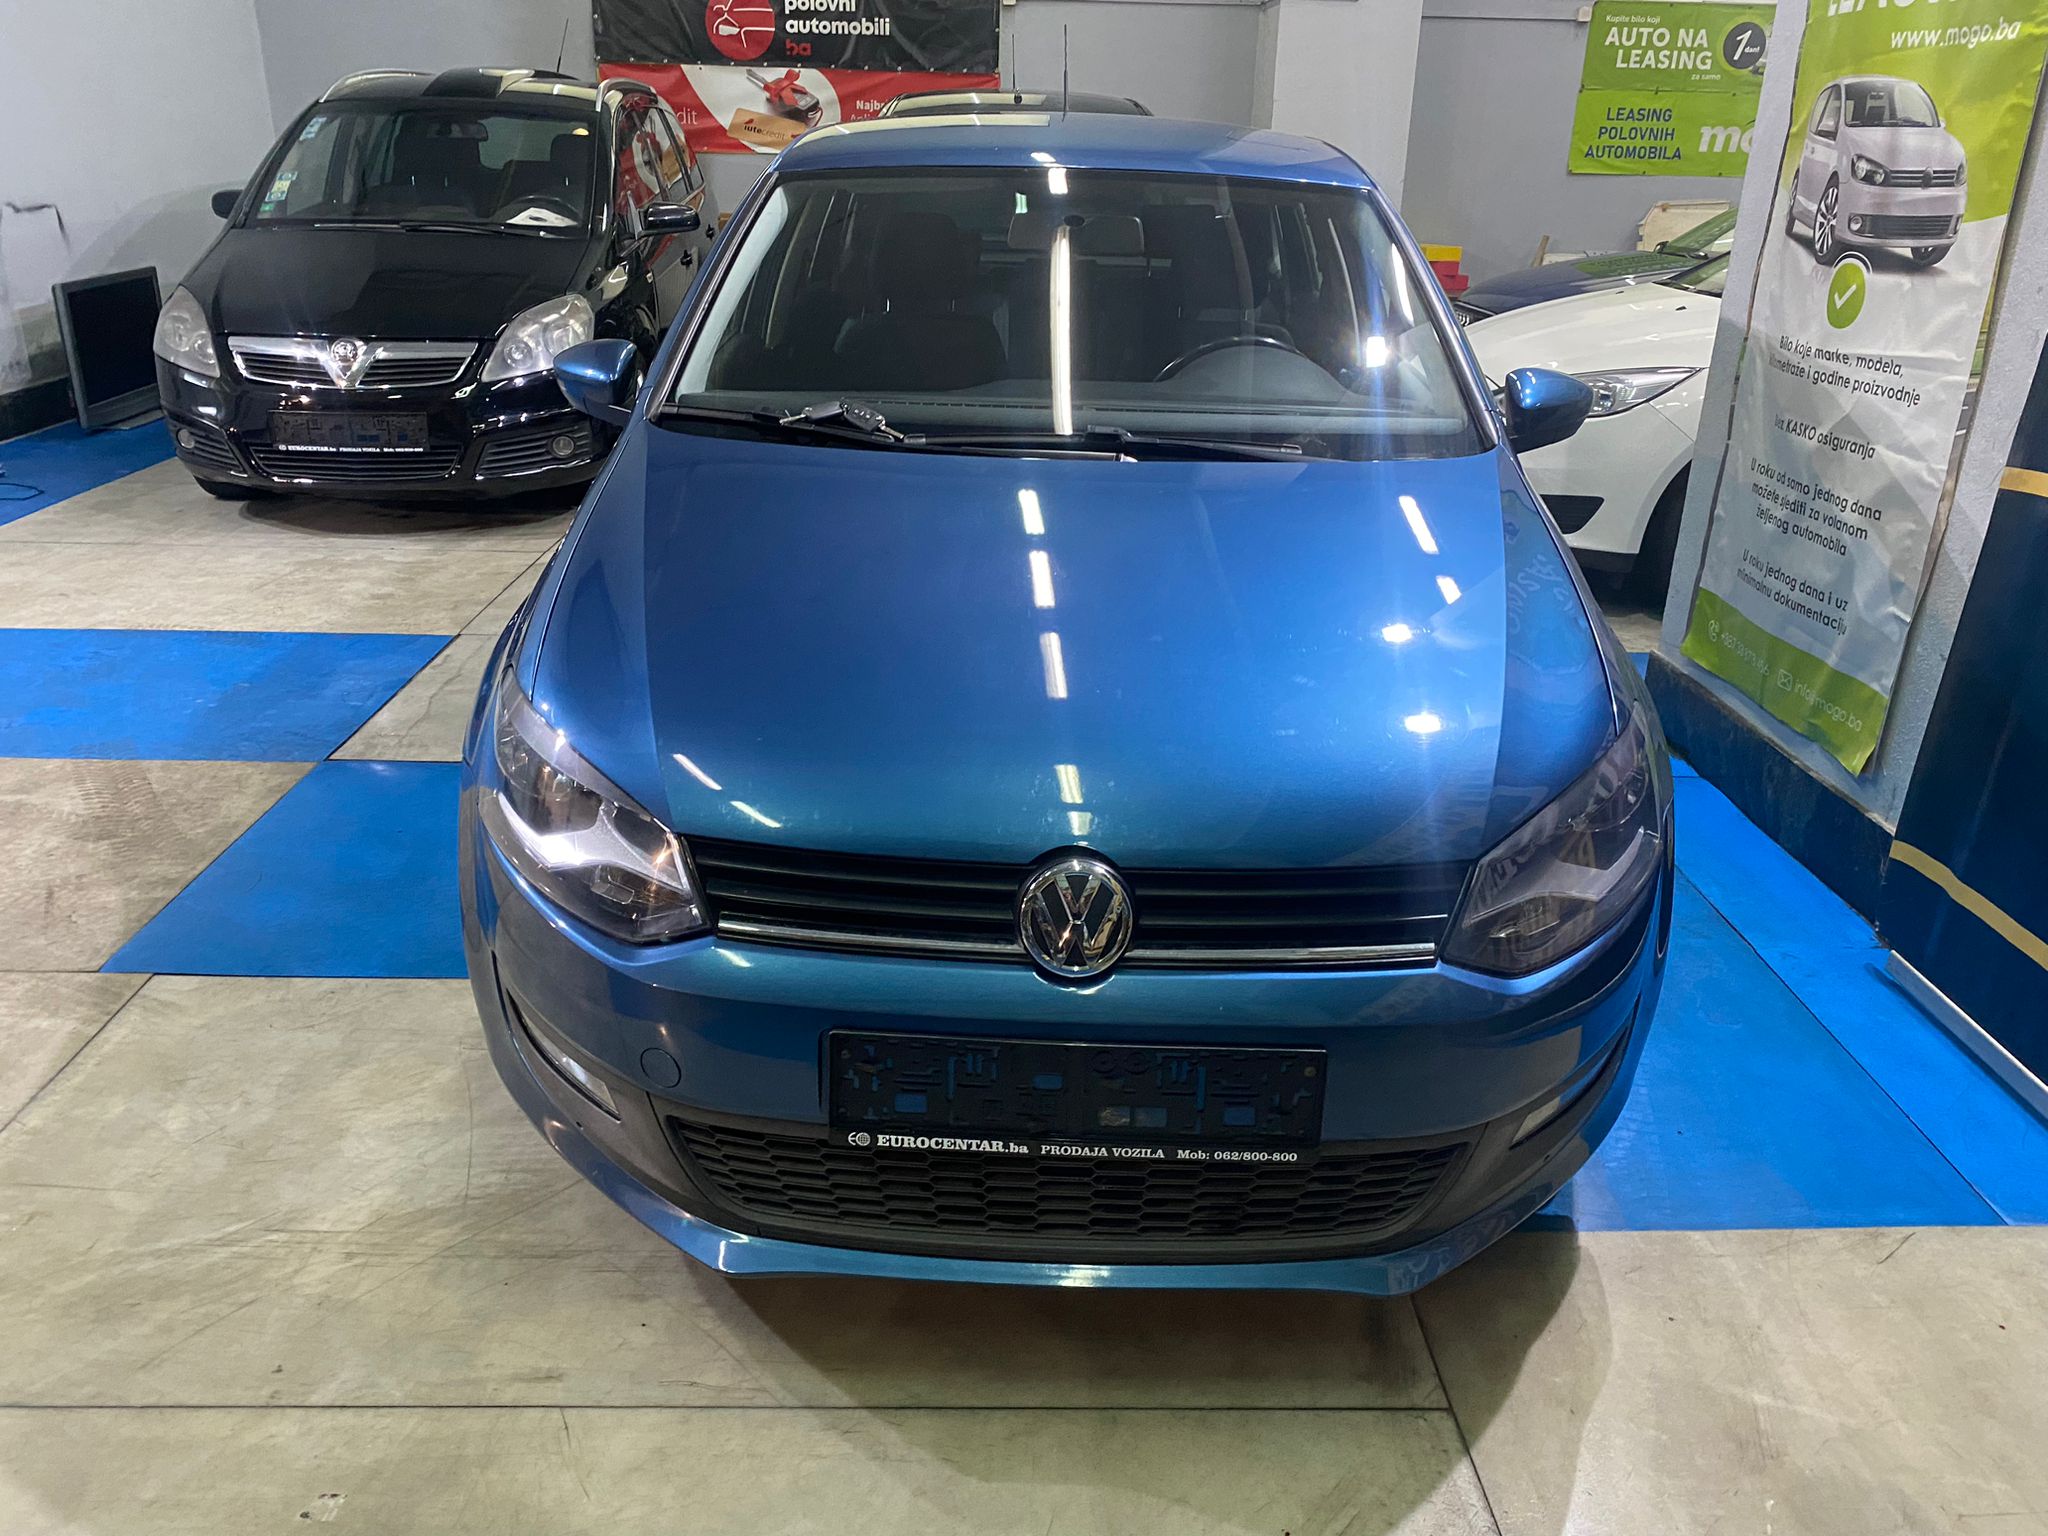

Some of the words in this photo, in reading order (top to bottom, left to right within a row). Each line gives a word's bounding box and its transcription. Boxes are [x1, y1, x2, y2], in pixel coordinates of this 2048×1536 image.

[784, 0, 856, 14] polovni
[1631, 14, 1646, 22] bilo
[785, 17, 890, 36] automobili
[1604, 27, 1670, 47] AUTO
[1677, 28, 1709, 48] NA
[1891, 17, 2022, 49] www.mogo.ba
[1733, 30, 1752, 60] 1
[1615, 49, 1713, 70] LEASING
[676, 106, 698, 125] dit
[856, 99, 886, 112] Najbr
[1606, 107, 1673, 122] LEASING
[1598, 126, 1675, 141] POLOVNIH
[1698, 125, 1754, 153] mo
[1584, 145, 1682, 161] AUTOMOBILA
[1779, 335, 1793, 352] Bilo
[1794, 339, 1812, 360] koje
[1814, 348, 1852, 367] marke,
[1856, 356, 1904, 379] modela,
[1806, 365, 1812, 380] i
[1812, 369, 1851, 388] godine
[1851, 378, 1921, 407] proizvodnje
[1785, 418, 1817, 440] KASKO
[1817, 431, 1876, 461] osiguranja
[1750, 458, 1757, 471] U
[1756, 462, 1776, 480] roku
[1776, 471, 1786, 485] od
[1786, 478, 1810, 495] samo
[1812, 483, 1849, 513] jednog
[1850, 499, 1882, 521] dana
[1751, 481, 1780, 504] možete
[1808, 507, 1821, 521] za
[1823, 513, 1869, 541] volanom
[1756, 504, 1790, 535] željenog
[1792, 523, 1847, 556] automobila
[1742, 548, 1749, 562] U
[1764, 562, 1798, 592] jednog
[1799, 580, 1825, 602] dana
[1827, 591, 1832, 606] i
[1835, 597, 1849, 612] uz
[1773, 590, 1848, 636] dokumentaciju
[877, 1134, 1029, 1154] EUROCENTAR.ba
[1040, 1144, 1109, 1158] PRODAJA
[1112, 1147, 1165, 1159] VOZILA
[1176, 1149, 1211, 1161] Mob:
[1214, 1150, 1298, 1162] 062/800-800
